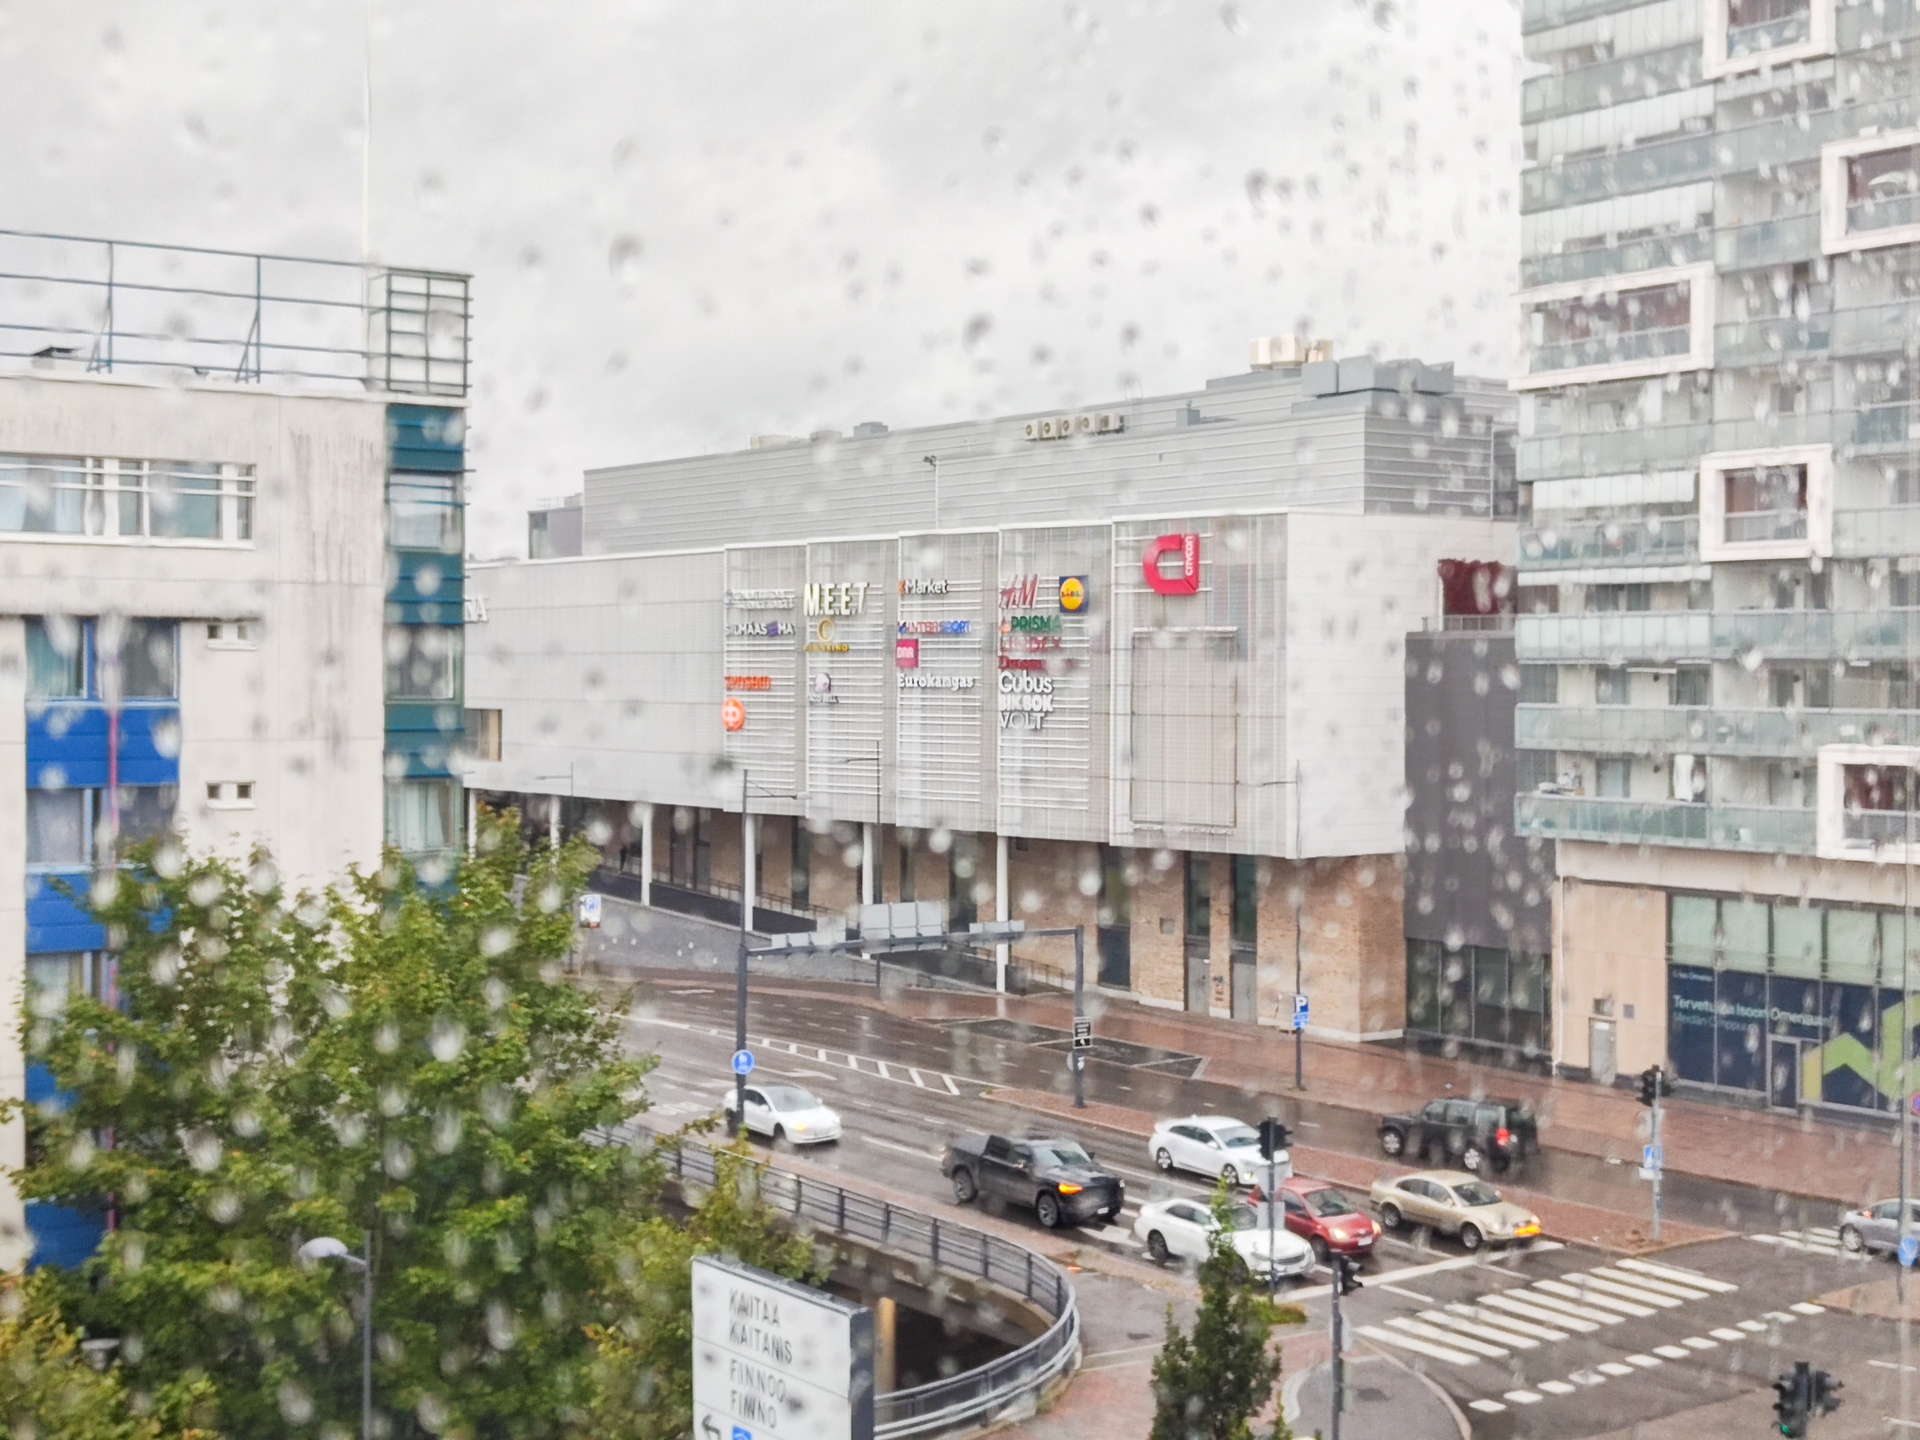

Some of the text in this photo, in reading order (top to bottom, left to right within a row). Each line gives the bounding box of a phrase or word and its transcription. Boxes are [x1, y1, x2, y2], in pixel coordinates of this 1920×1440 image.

[905, 579, 948, 594] Market
[1010, 615, 1062, 632] PRISMA
[897, 673, 974, 691] Eurokangas
[999, 712, 1045, 729] VOLT
[729, 1287, 780, 1328] KAITAA
[729, 1358, 787, 1403] FINNOO
